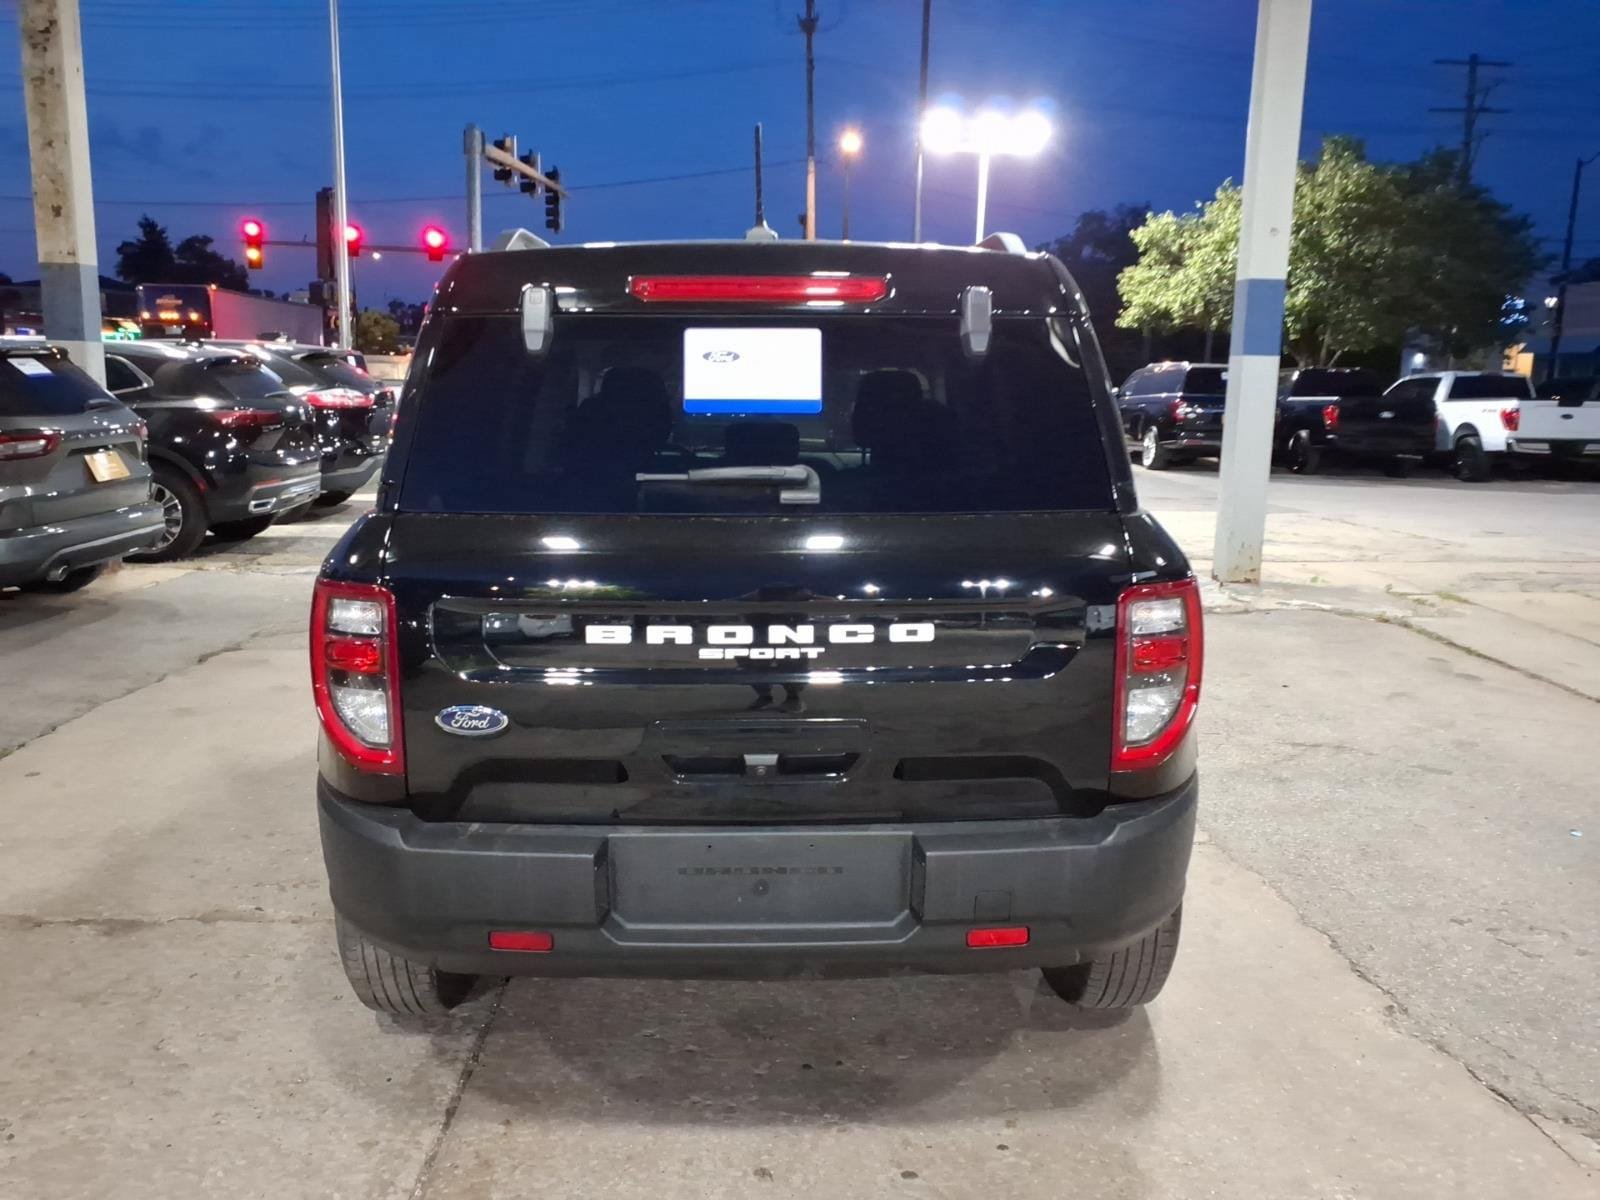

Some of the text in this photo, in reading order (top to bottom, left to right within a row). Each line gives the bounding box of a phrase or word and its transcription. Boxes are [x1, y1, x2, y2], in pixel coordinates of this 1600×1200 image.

[585, 622, 935, 645] BRONCO
[698, 647, 825, 660] SPORT
[450, 709, 490, 729] Ford
